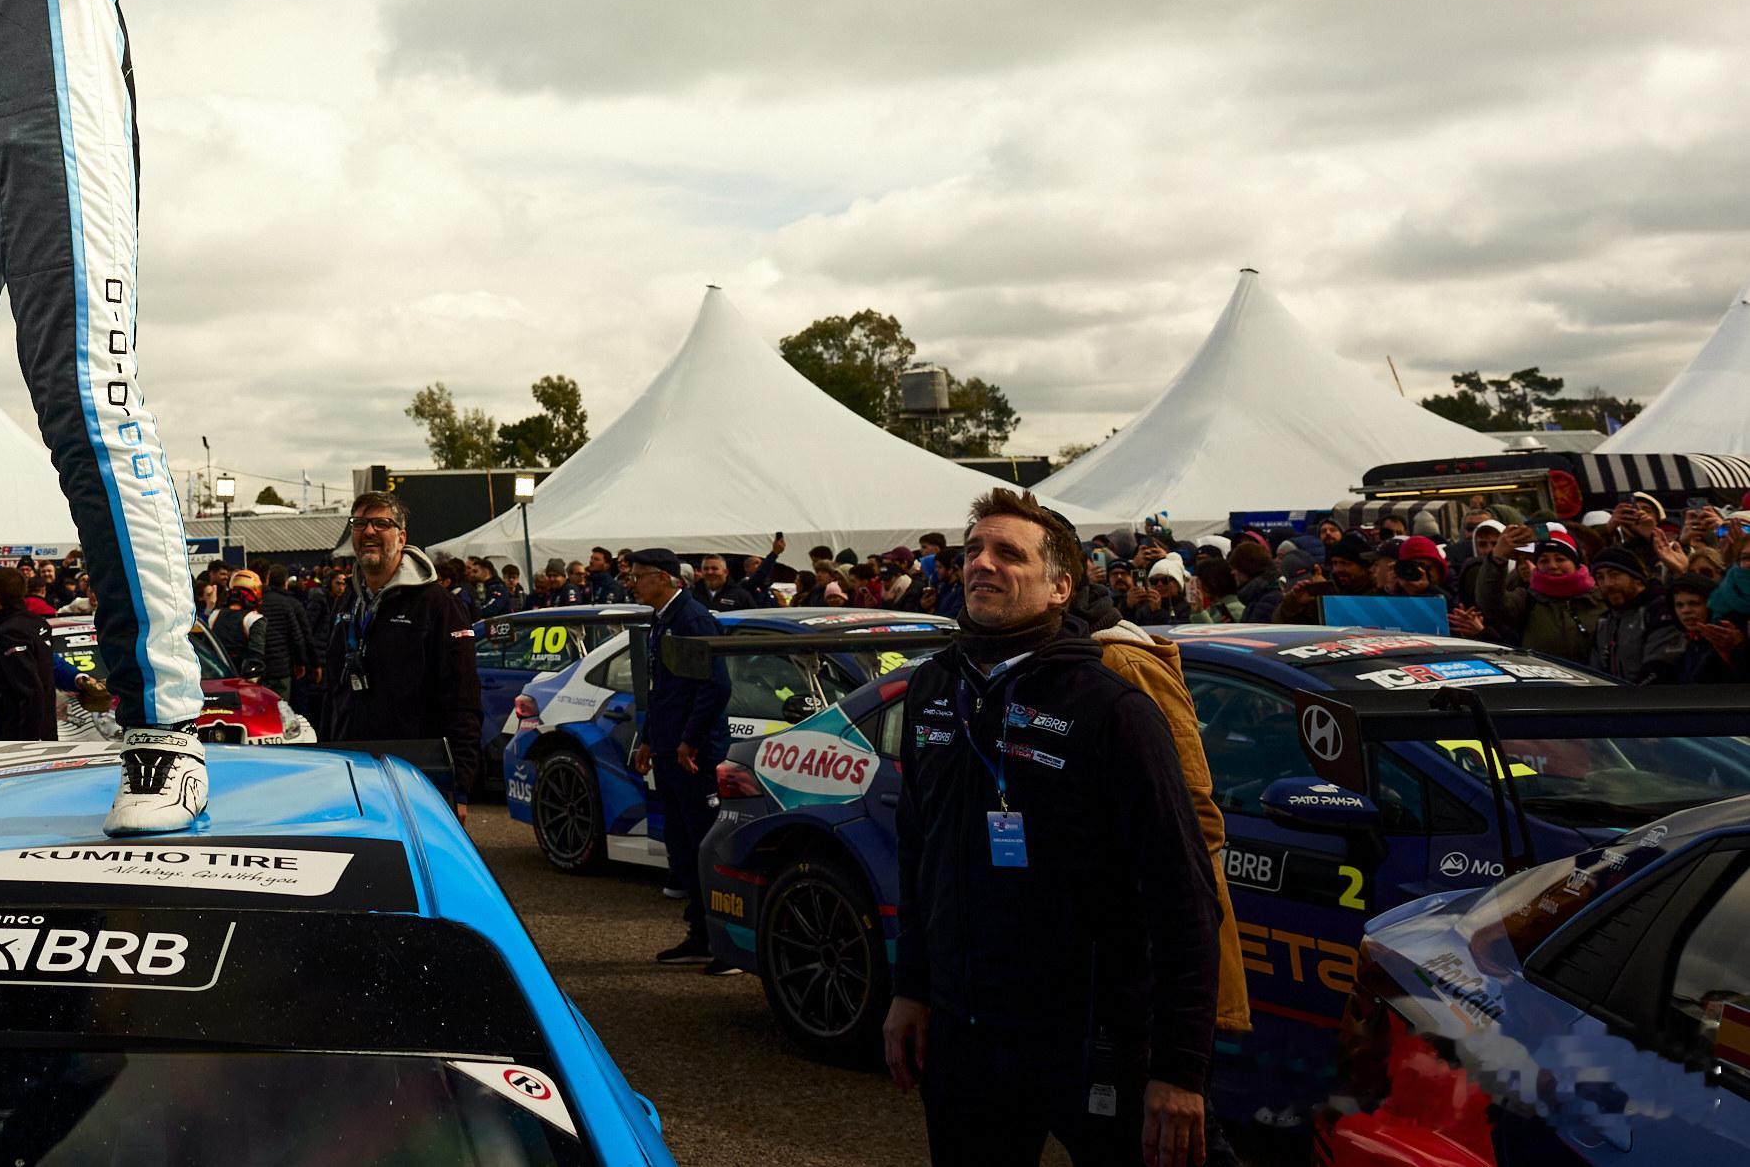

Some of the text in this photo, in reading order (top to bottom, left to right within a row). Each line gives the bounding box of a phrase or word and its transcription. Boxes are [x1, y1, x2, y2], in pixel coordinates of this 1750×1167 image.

[530, 626, 567, 654] 10
[1355, 664, 1445, 689] TCR
[761, 741, 870, 785] 100 AÑOS
[1288, 795, 1364, 808] PATO PAMPA
[18, 851, 299, 871] KUMHO TIRE
[1227, 850, 1272, 882] BRB
[1338, 865, 1366, 910] 2
[36, 929, 189, 976] BRB
